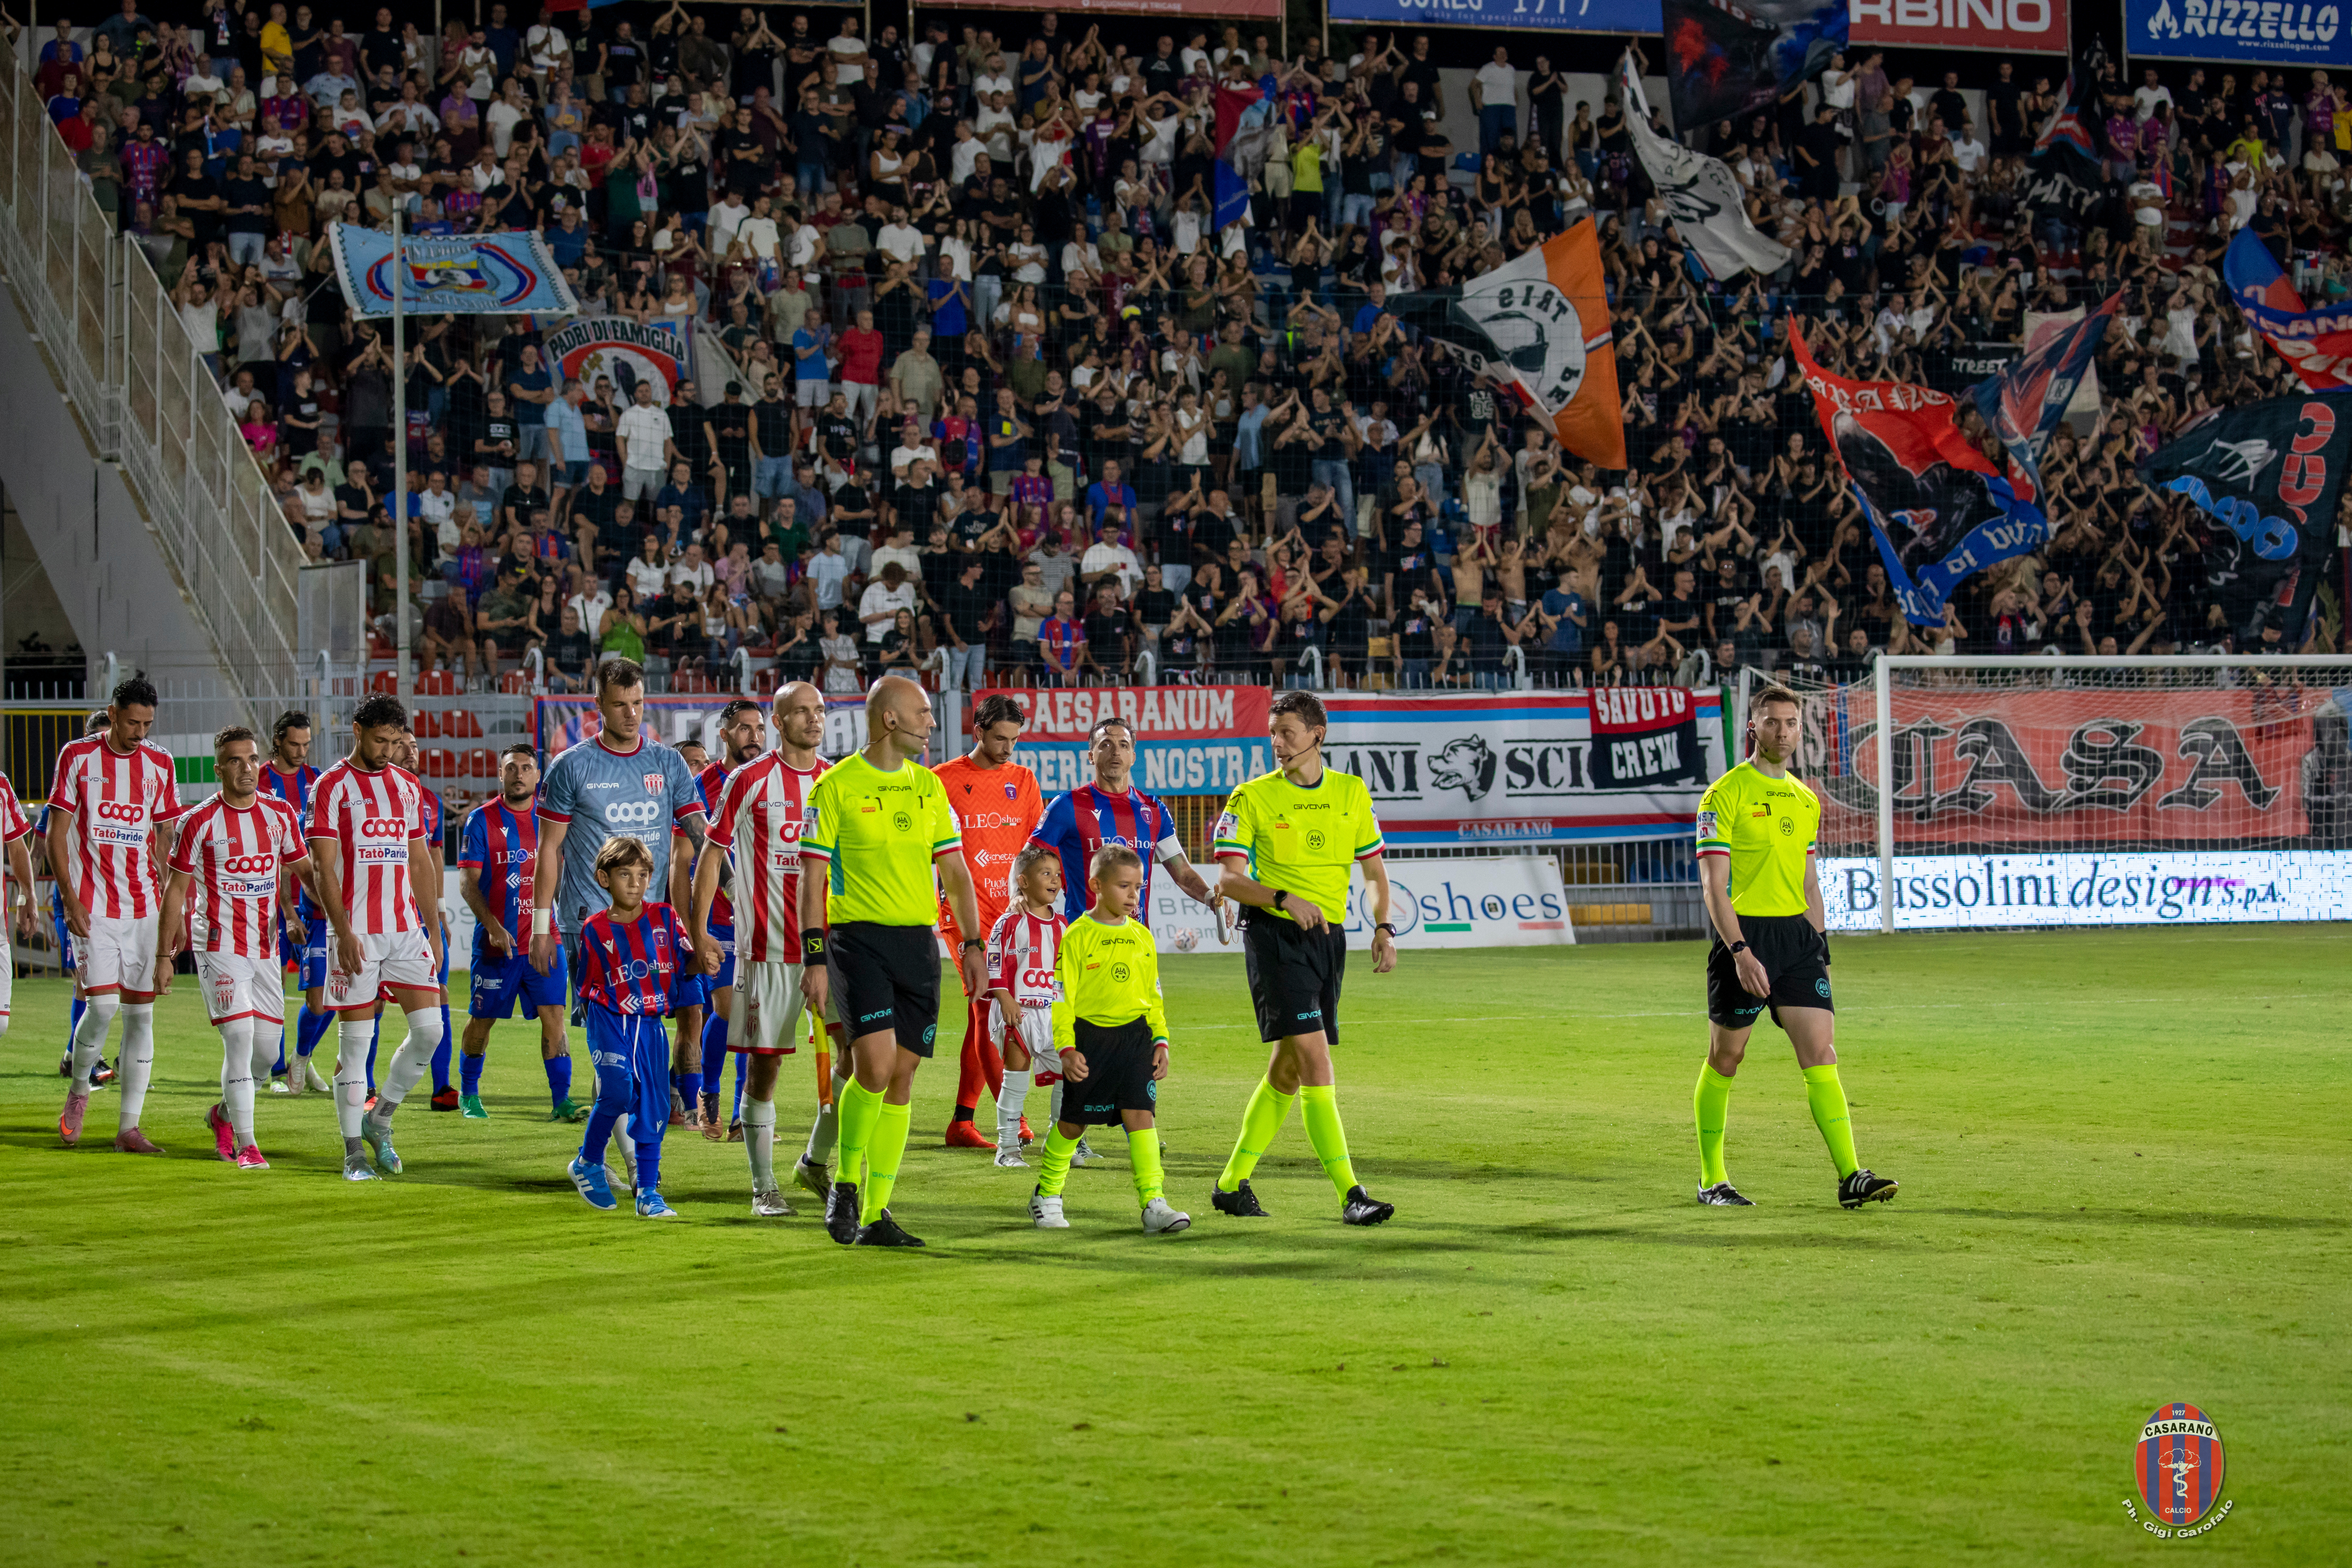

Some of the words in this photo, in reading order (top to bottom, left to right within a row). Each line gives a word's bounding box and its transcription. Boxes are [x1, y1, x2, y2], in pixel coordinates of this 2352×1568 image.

[1481, 13, 1524, 22] special
[1529, 16, 1567, 26] people
[2184, 0, 2339, 42] RIZZELLO
[2237, 39, 2330, 51] www.rizzellogas.com
[549, 323, 591, 362] PADRI
[591, 320, 609, 341] DI
[610, 319, 685, 362] FAMIGLIA
[1013, 689, 1235, 732] CAESARANUM
[1611, 731, 1681, 780] CREW
[1144, 746, 1267, 789] NOSTRA
[1321, 750, 1420, 792] ANI
[1820, 715, 2282, 823] CASA
[98, 802, 144, 826] coop
[342, 799, 373, 808] GIVOVA
[605, 801, 660, 825] coop
[361, 818, 406, 841] coop
[1458, 821, 1553, 837] CASARANO
[206, 837, 237, 846] GIVOVA
[359, 847, 407, 859] TatòParide
[224, 854, 274, 875] coop
[221, 881, 274, 892] TatòParide
[1008, 947, 1038, 955] GIVOVA
[861, 1008, 892, 1022] GIVOVA
[1297, 1009, 1322, 1020] GIVOVA
